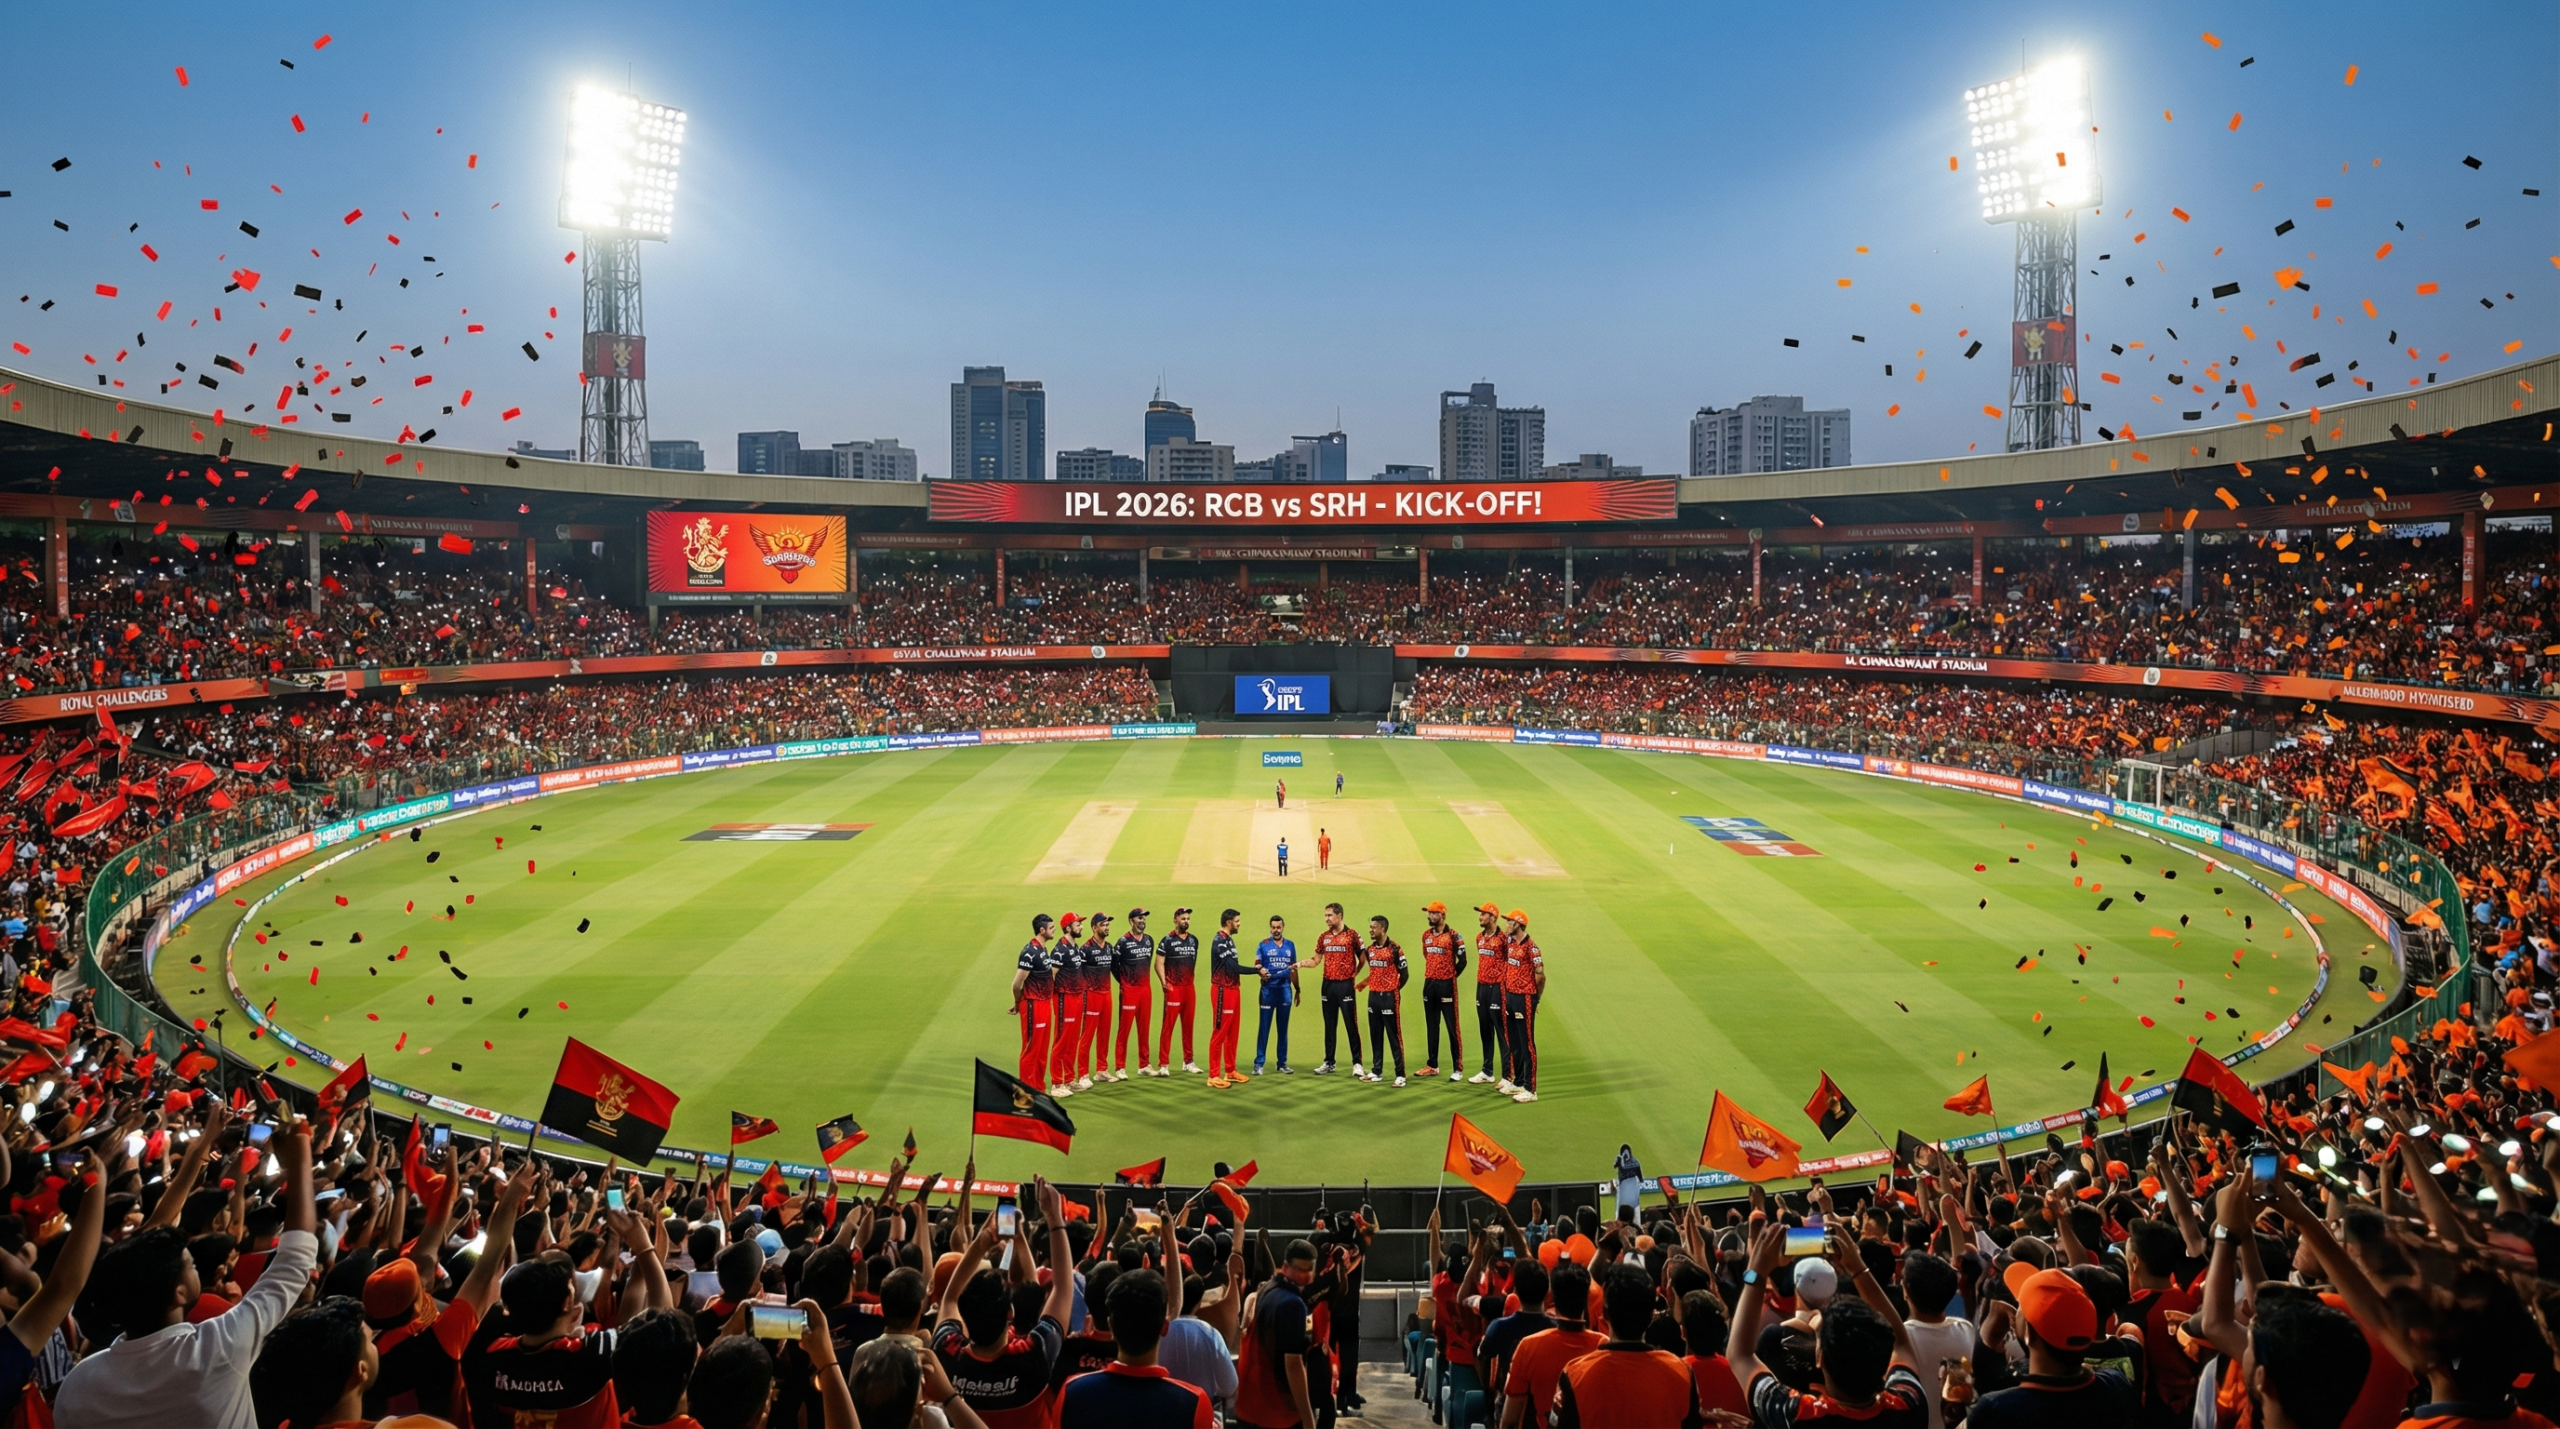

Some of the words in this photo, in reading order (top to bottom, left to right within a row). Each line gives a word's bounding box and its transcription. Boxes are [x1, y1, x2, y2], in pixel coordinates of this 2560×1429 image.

[1065, 491, 1109, 517] IPL
[1115, 492, 1195, 518] 2026:
[1205, 492, 1264, 517] RCB
[1270, 497, 1301, 518] vs
[1309, 492, 1366, 518] SRH
[1395, 490, 1541, 517] KICK-OFF!
[60, 695, 94, 711] ROYAL
[96, 688, 168, 706] CHALLENGERS
[1277, 694, 1305, 711] IPL
